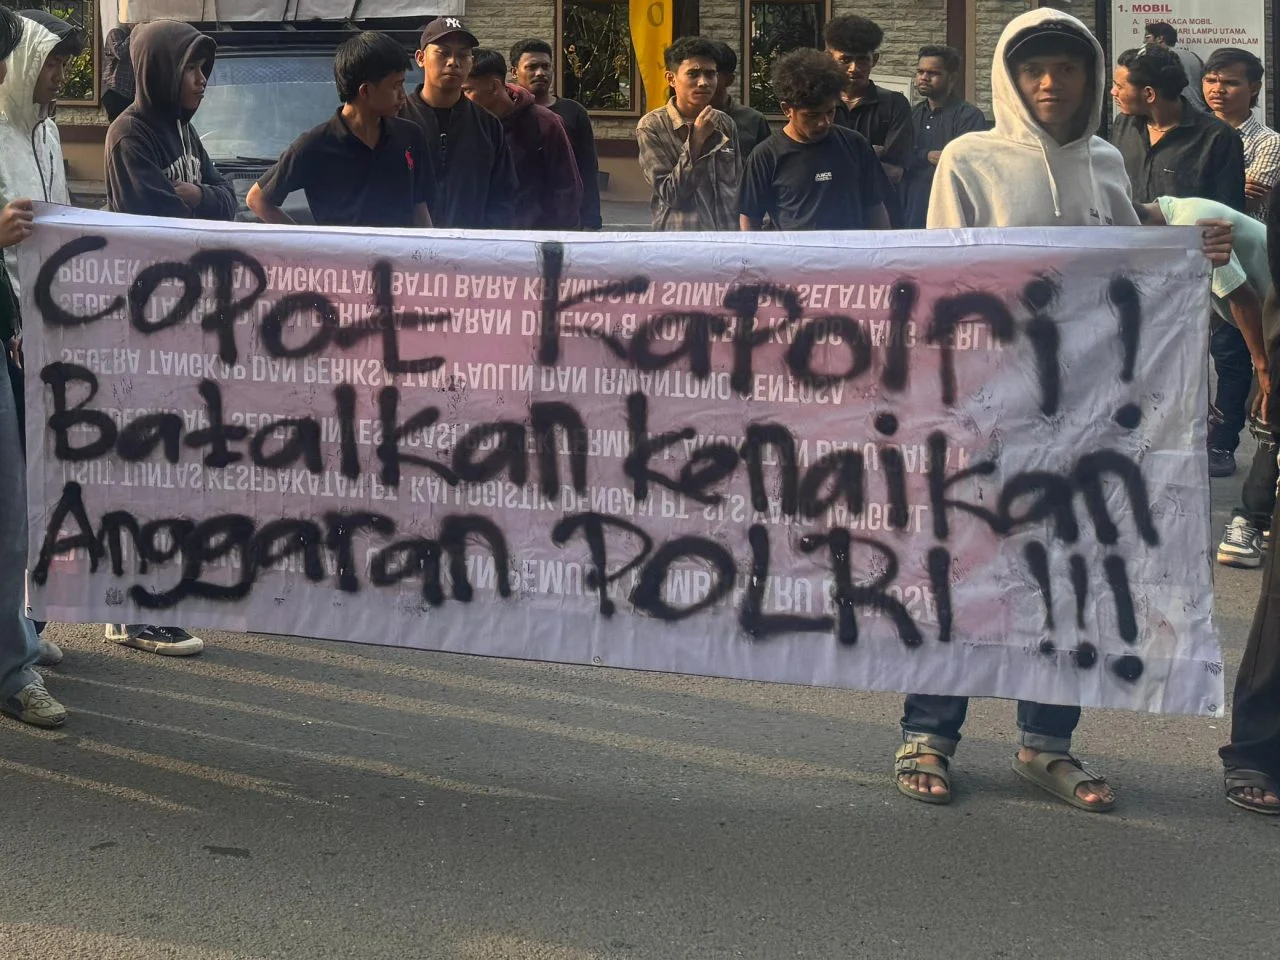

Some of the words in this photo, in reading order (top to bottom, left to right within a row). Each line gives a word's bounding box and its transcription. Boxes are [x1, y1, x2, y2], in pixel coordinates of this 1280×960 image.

[1118, 4, 1128, 13] 1.
[1132, 4, 1172, 13] MOBIL
[552, 511, 951, 647] POLRI
